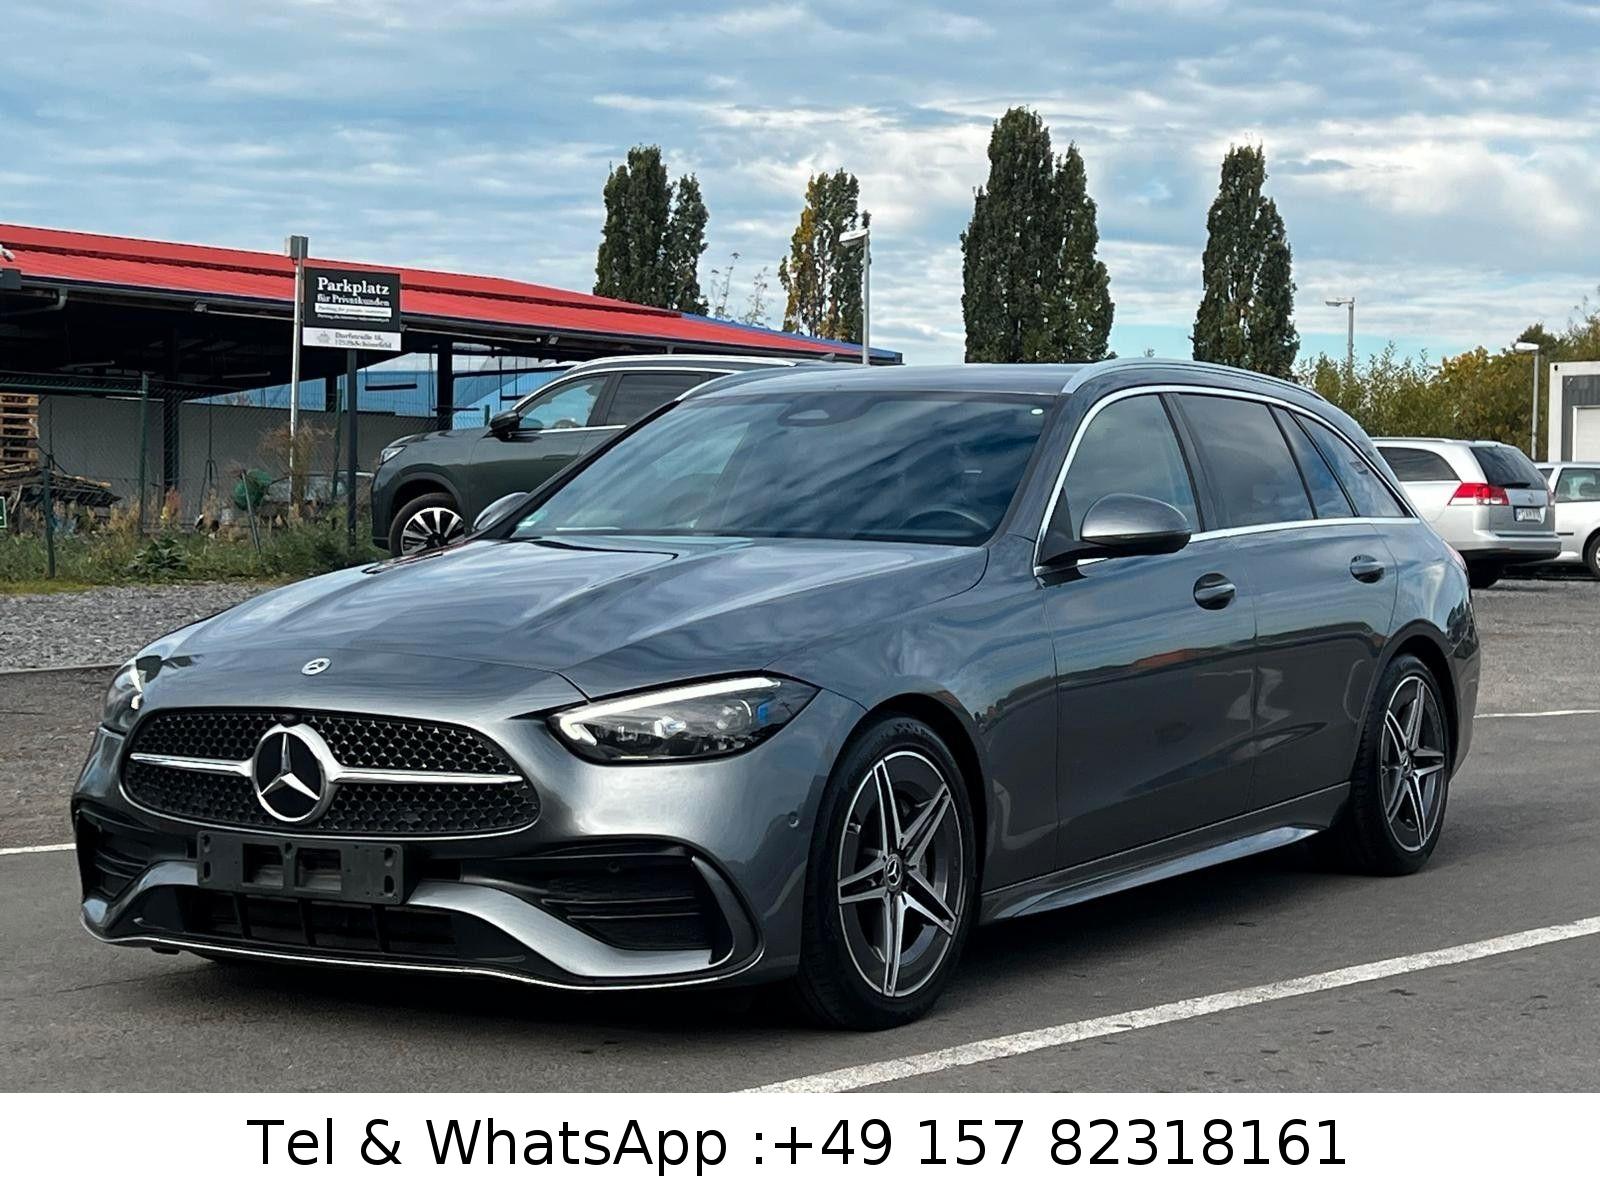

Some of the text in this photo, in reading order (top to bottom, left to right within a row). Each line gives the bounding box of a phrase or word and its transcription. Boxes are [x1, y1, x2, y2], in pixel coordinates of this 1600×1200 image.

[317, 277, 390, 296] Parkplatz
[317, 294, 390, 306] für Privatkunden
